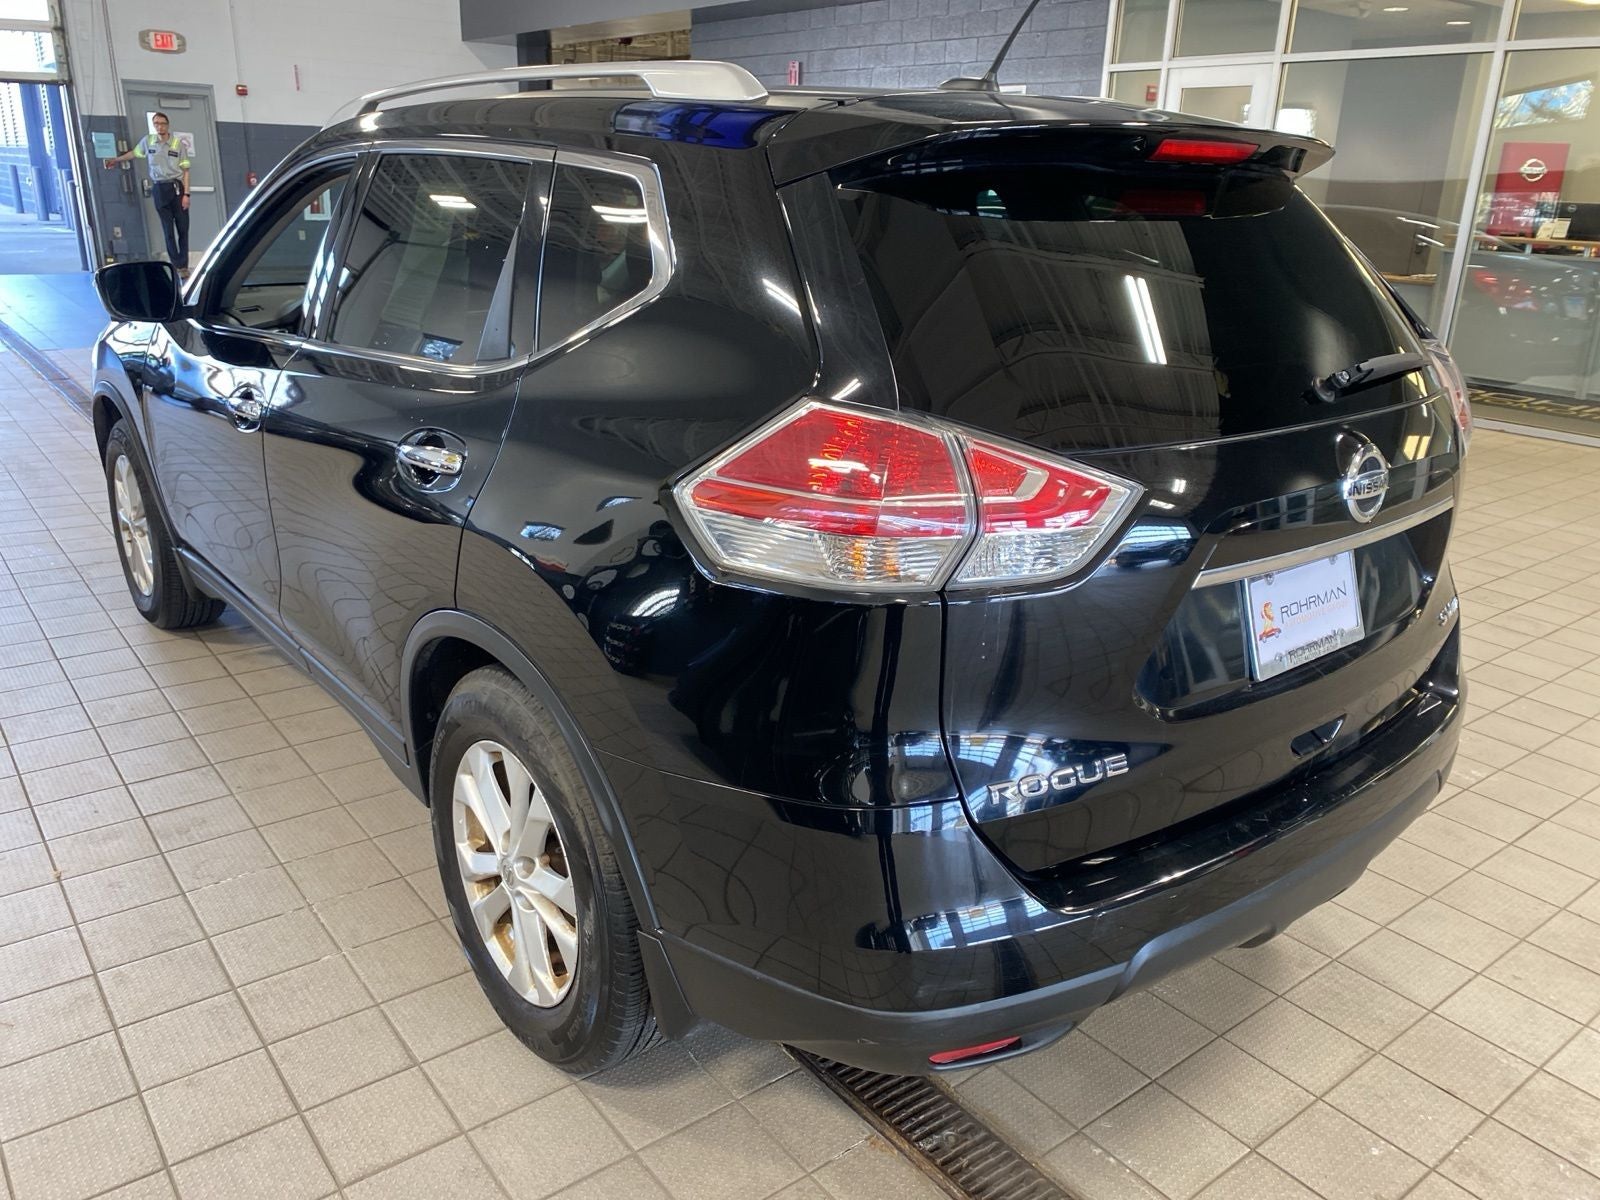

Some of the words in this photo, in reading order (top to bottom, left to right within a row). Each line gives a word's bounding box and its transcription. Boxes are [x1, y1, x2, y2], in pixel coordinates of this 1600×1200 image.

[154, 32, 173, 49] EXIT
[1280, 580, 1347, 624] ROHRMAN
[987, 753, 1129, 805] ROGUE
